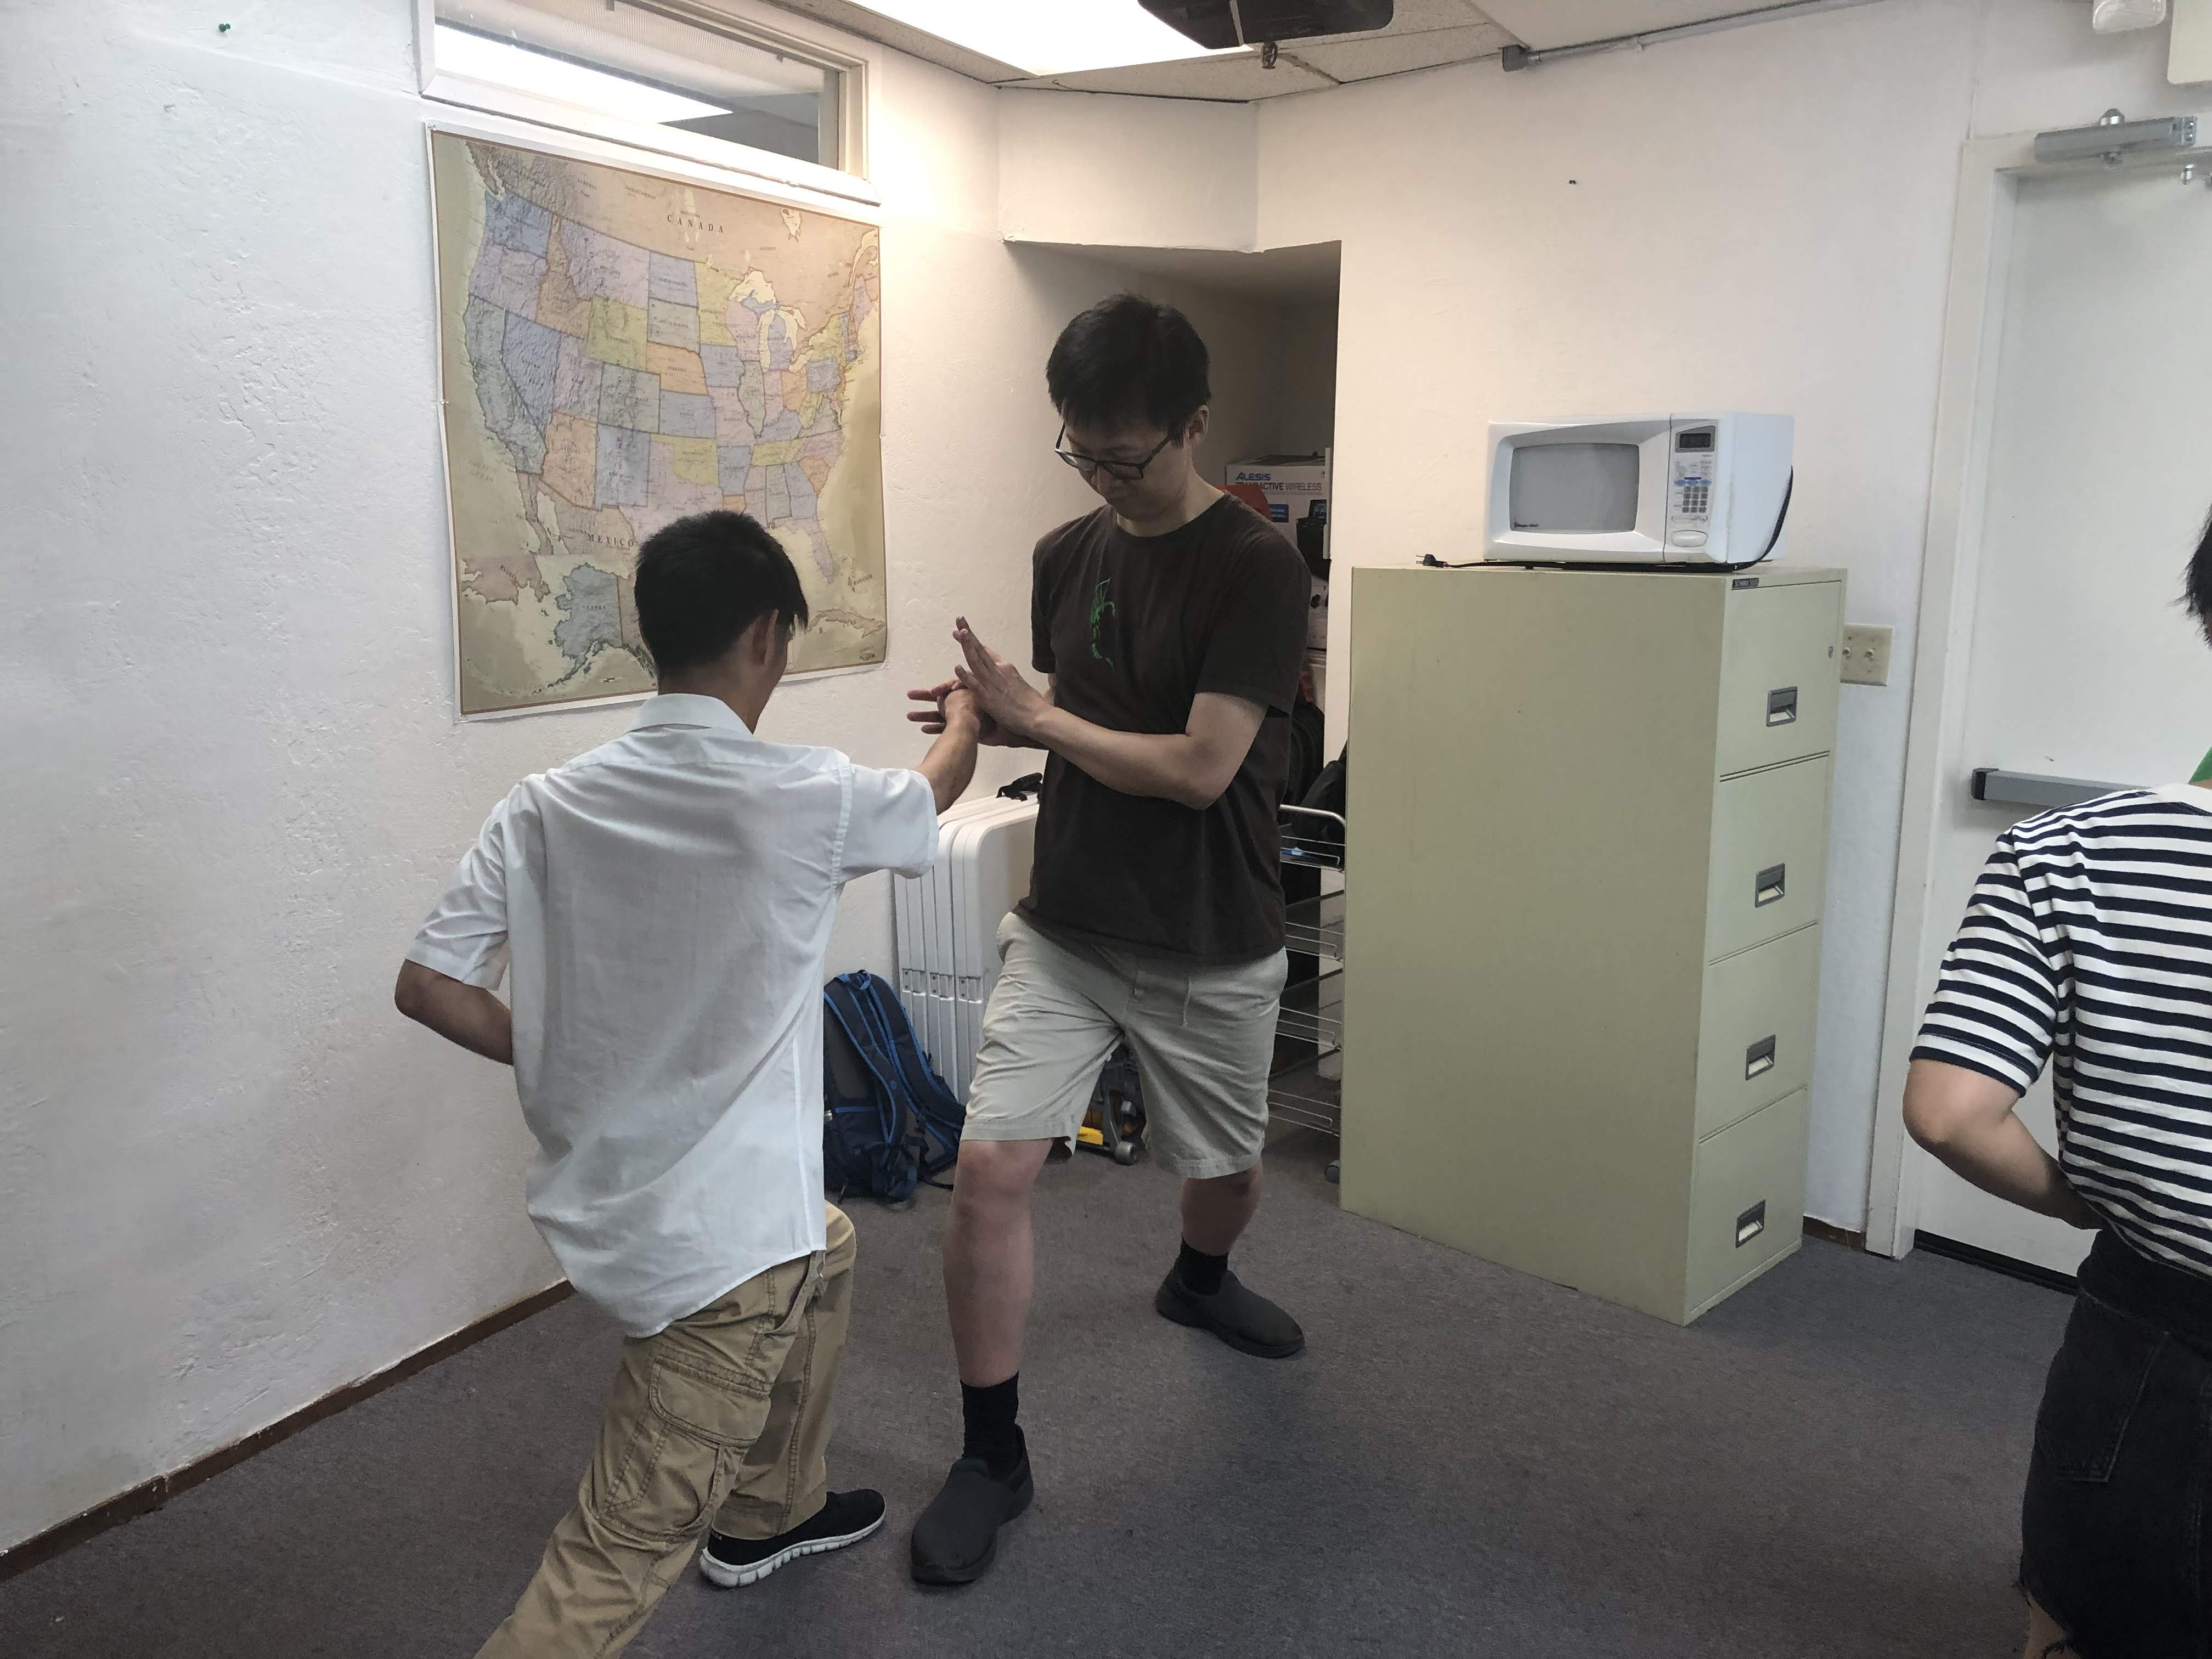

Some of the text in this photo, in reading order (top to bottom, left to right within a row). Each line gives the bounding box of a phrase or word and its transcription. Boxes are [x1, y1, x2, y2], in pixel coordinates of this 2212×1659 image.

[667, 215, 724, 233] CANADA
[1235, 472, 1271, 481] ALESIS
[1235, 482, 1322, 491] ACTIVE WIRELESS
[588, 534, 634, 548] MEXICO
